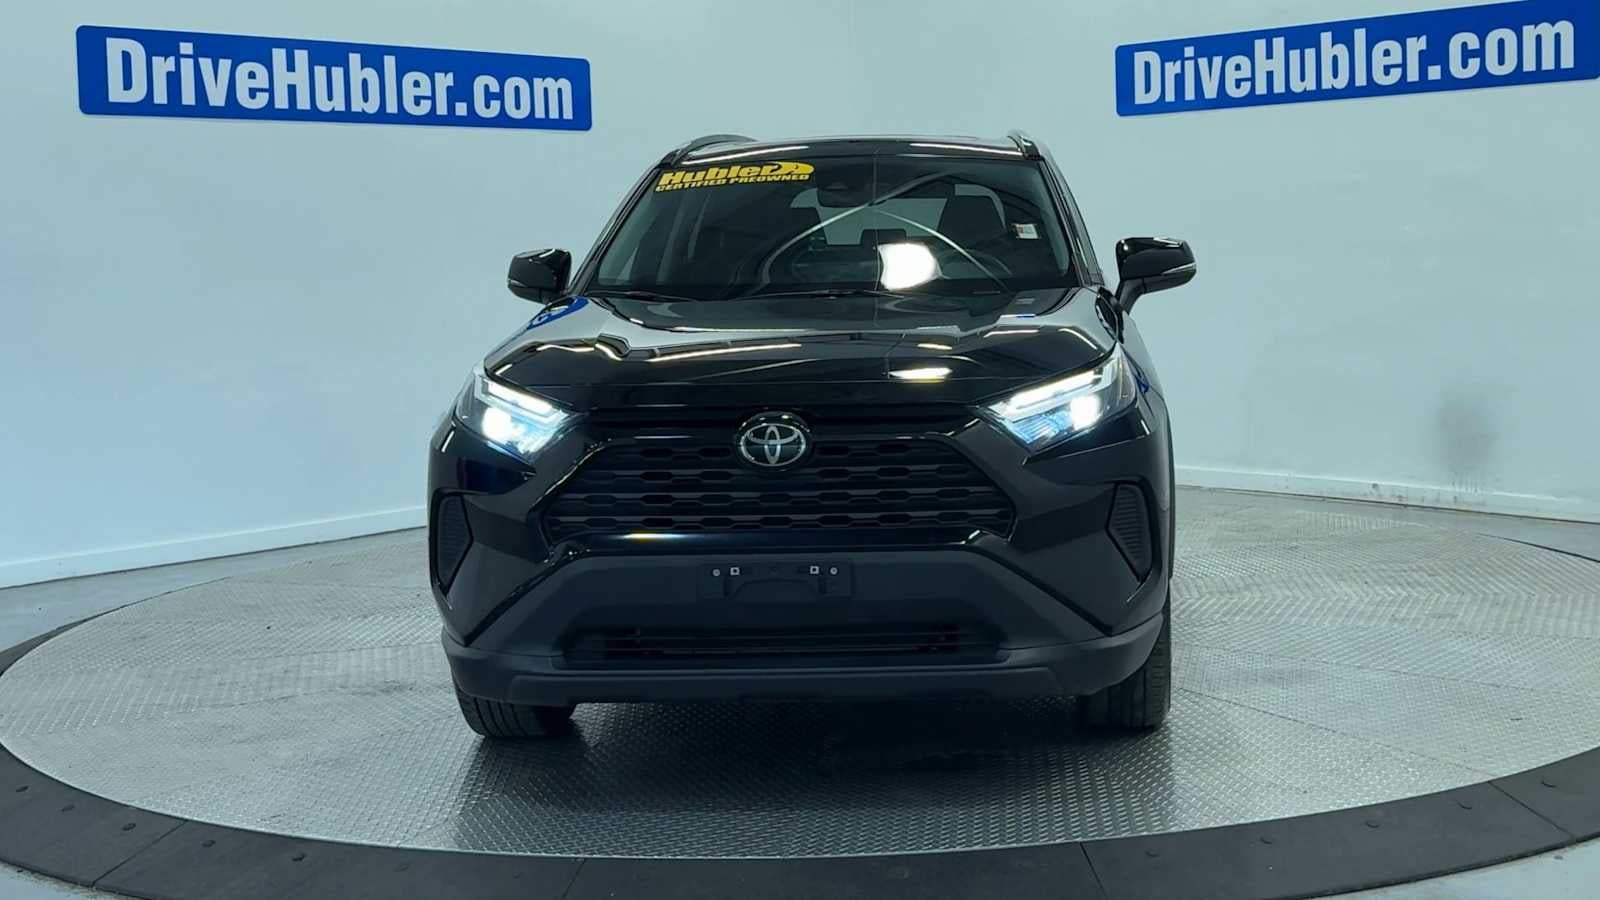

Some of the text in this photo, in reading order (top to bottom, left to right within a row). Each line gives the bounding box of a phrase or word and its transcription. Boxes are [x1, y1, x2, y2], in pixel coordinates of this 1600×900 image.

[105, 36, 574, 120] DriveHubler.com
[1133, 20, 1575, 105] DriveHubler.com
[655, 174, 810, 192] CERTIFIED PREOWNED
[658, 162, 782, 186] Hubler
